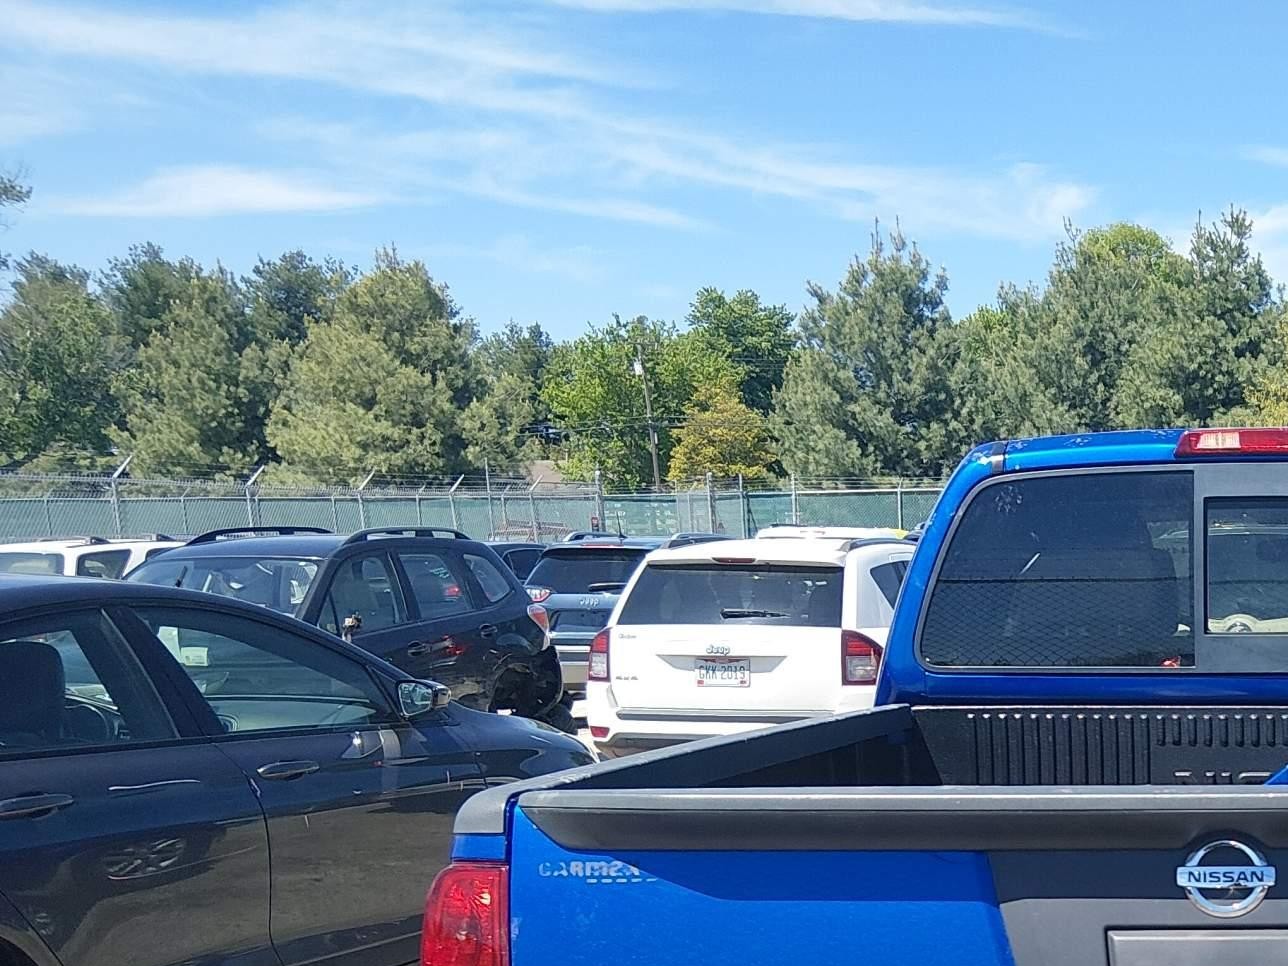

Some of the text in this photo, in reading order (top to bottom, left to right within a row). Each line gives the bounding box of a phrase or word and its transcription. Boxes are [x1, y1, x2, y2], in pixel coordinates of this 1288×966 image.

[705, 645, 730, 656] Jeep
[720, 665, 746, 680] 2019
[1187, 870, 1265, 884] NISSAN
